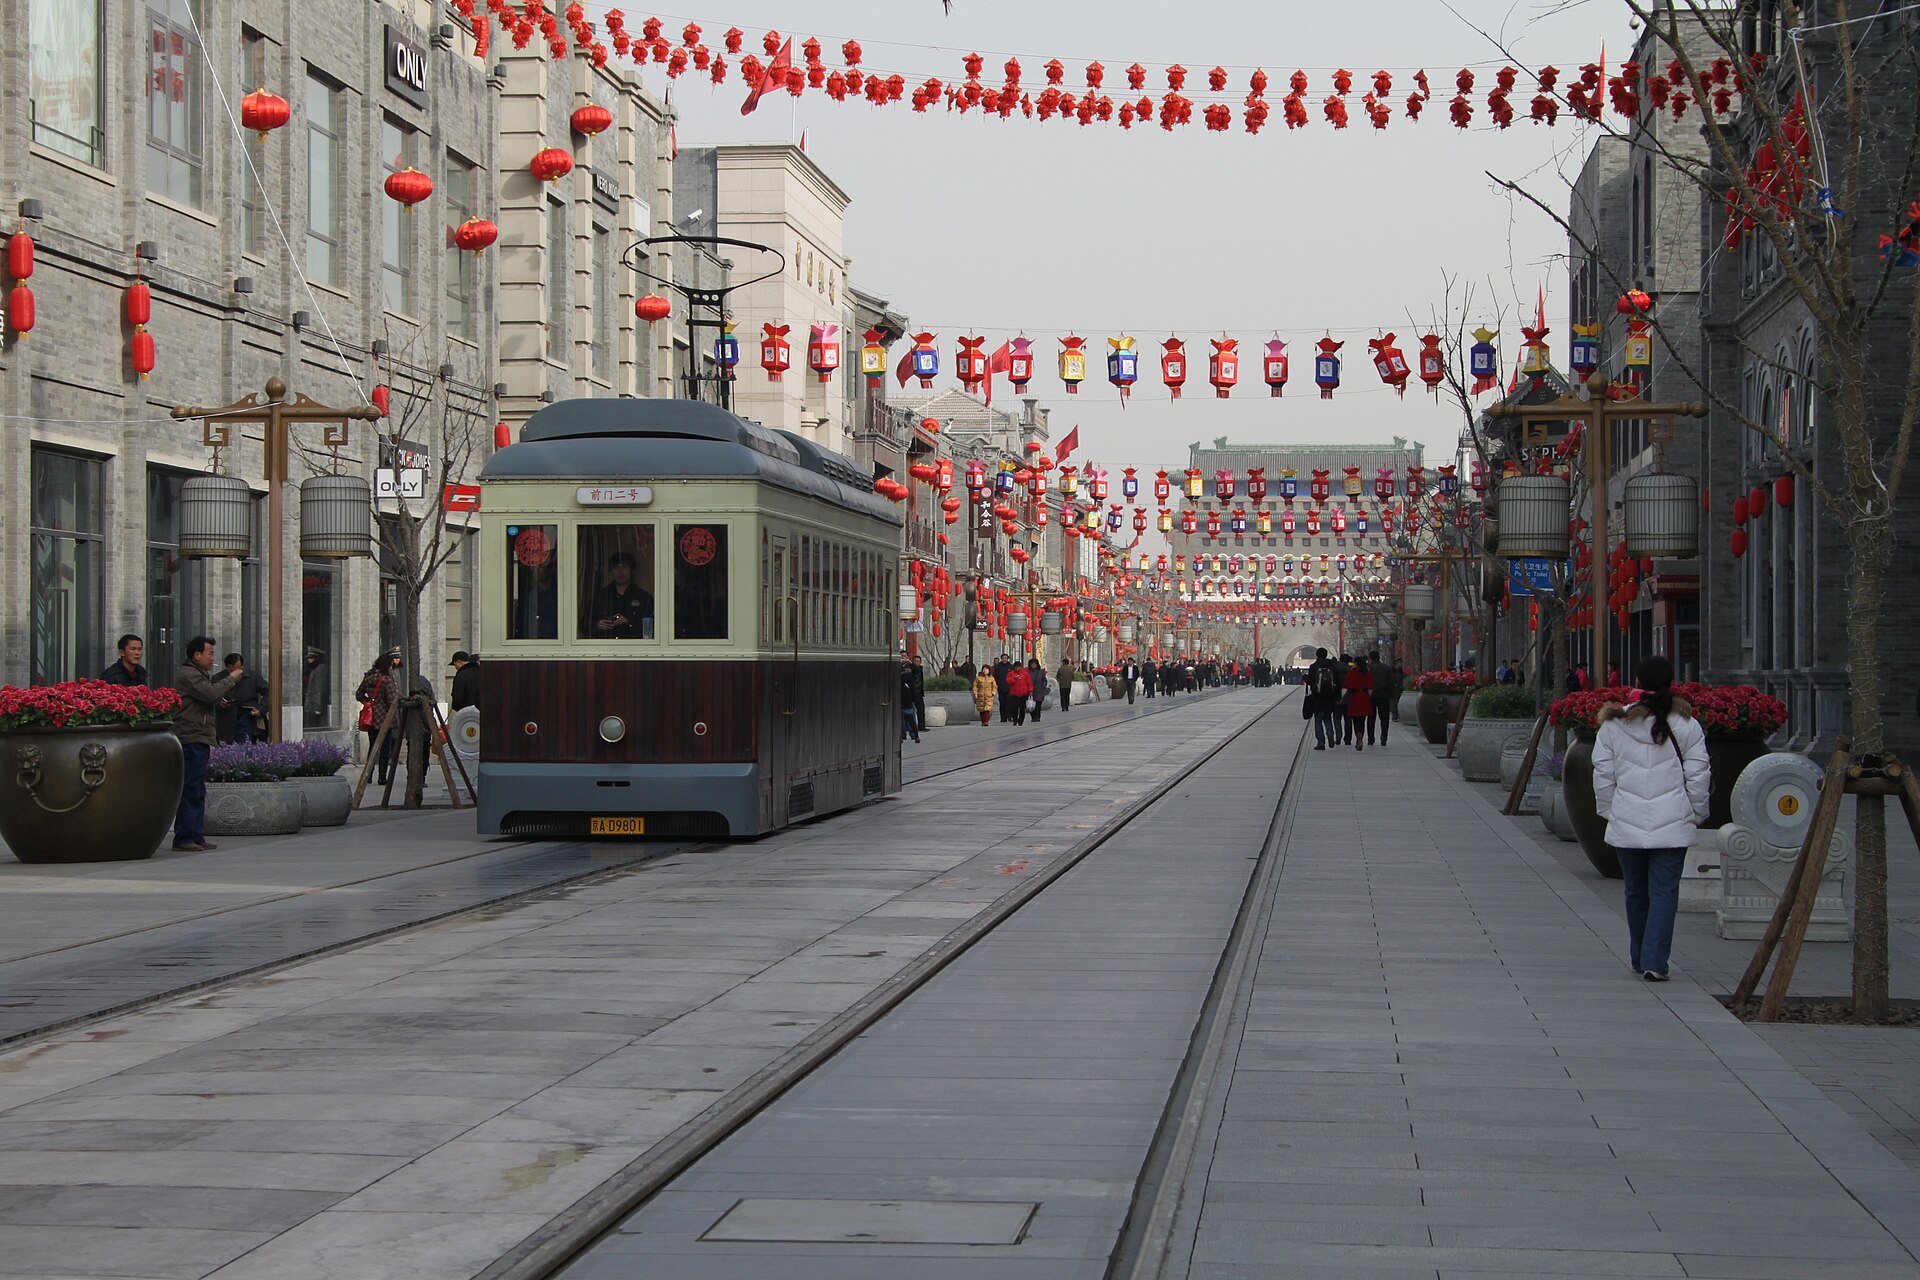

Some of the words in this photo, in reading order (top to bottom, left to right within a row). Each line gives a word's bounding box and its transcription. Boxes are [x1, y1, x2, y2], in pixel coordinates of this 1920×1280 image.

[395, 42, 428, 91] ONLY
[590, 488, 639, 502] 前门二号
[979, 500, 993, 527] 和合谷
